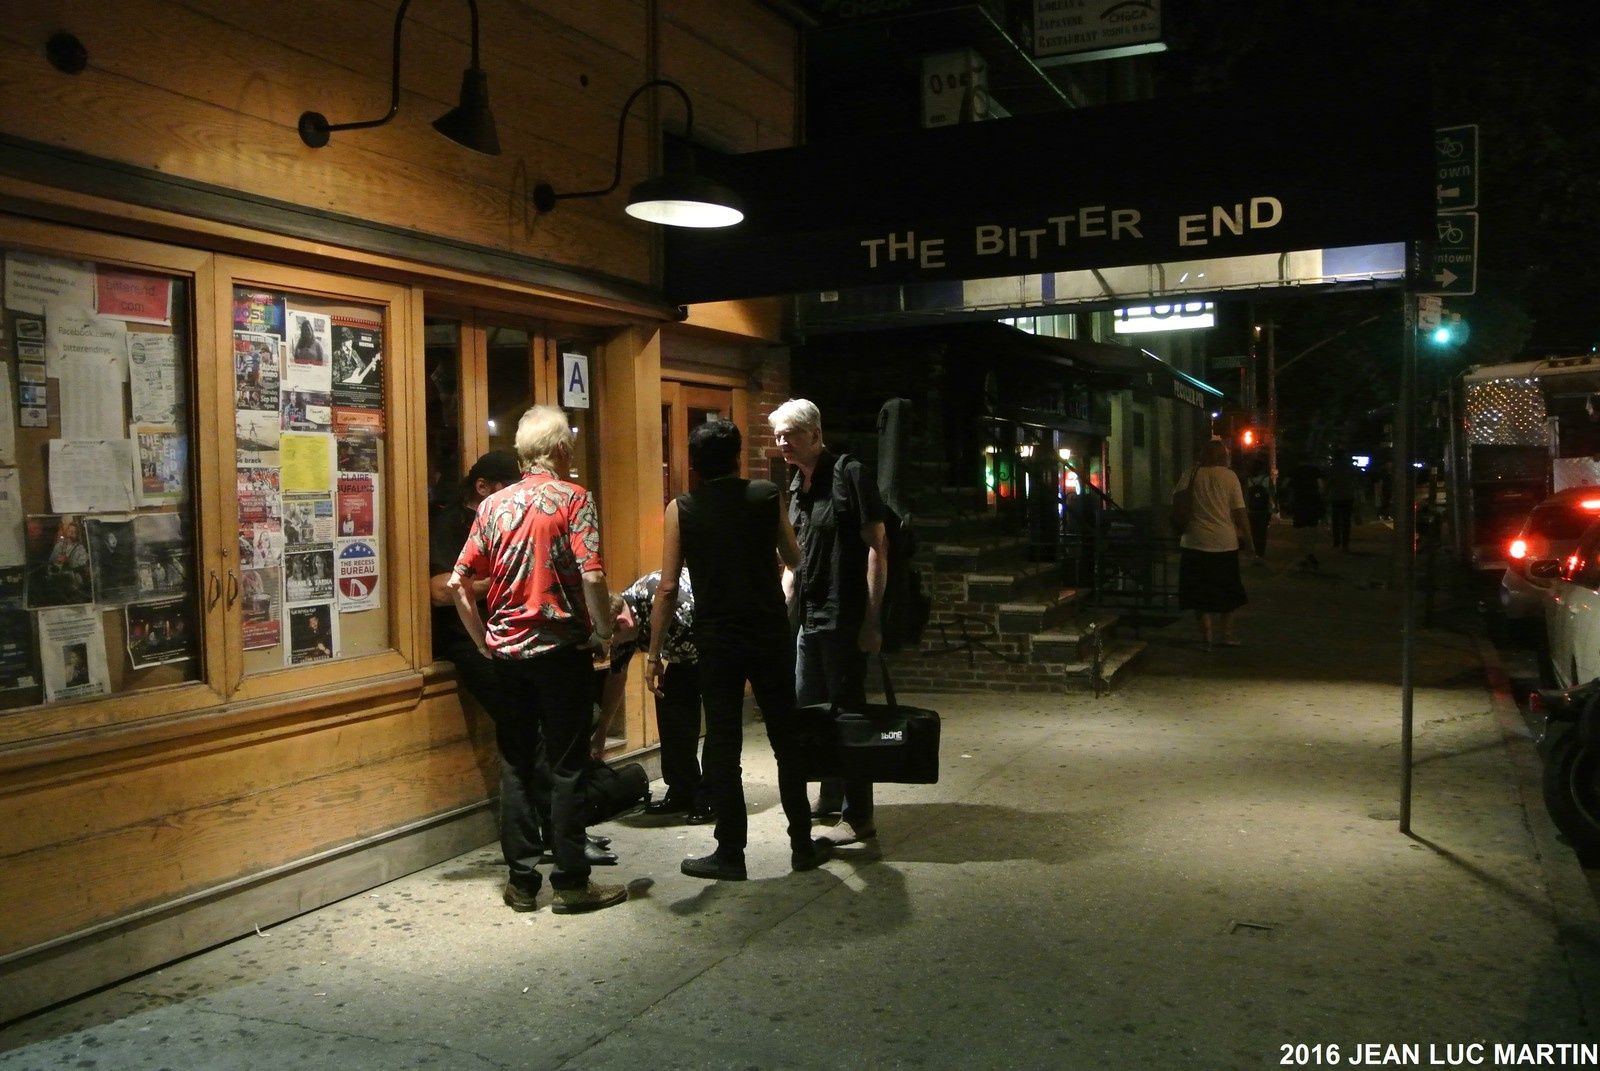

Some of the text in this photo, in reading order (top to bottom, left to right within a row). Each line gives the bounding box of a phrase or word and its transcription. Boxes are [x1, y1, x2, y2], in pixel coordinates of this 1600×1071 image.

[1439, 164, 1470, 180] own
[860, 196, 1283, 269] THE BITTER END
[568, 361, 585, 394] A
[341, 473, 369, 482] CLAIRE
[340, 565, 375, 576] BUREAU
